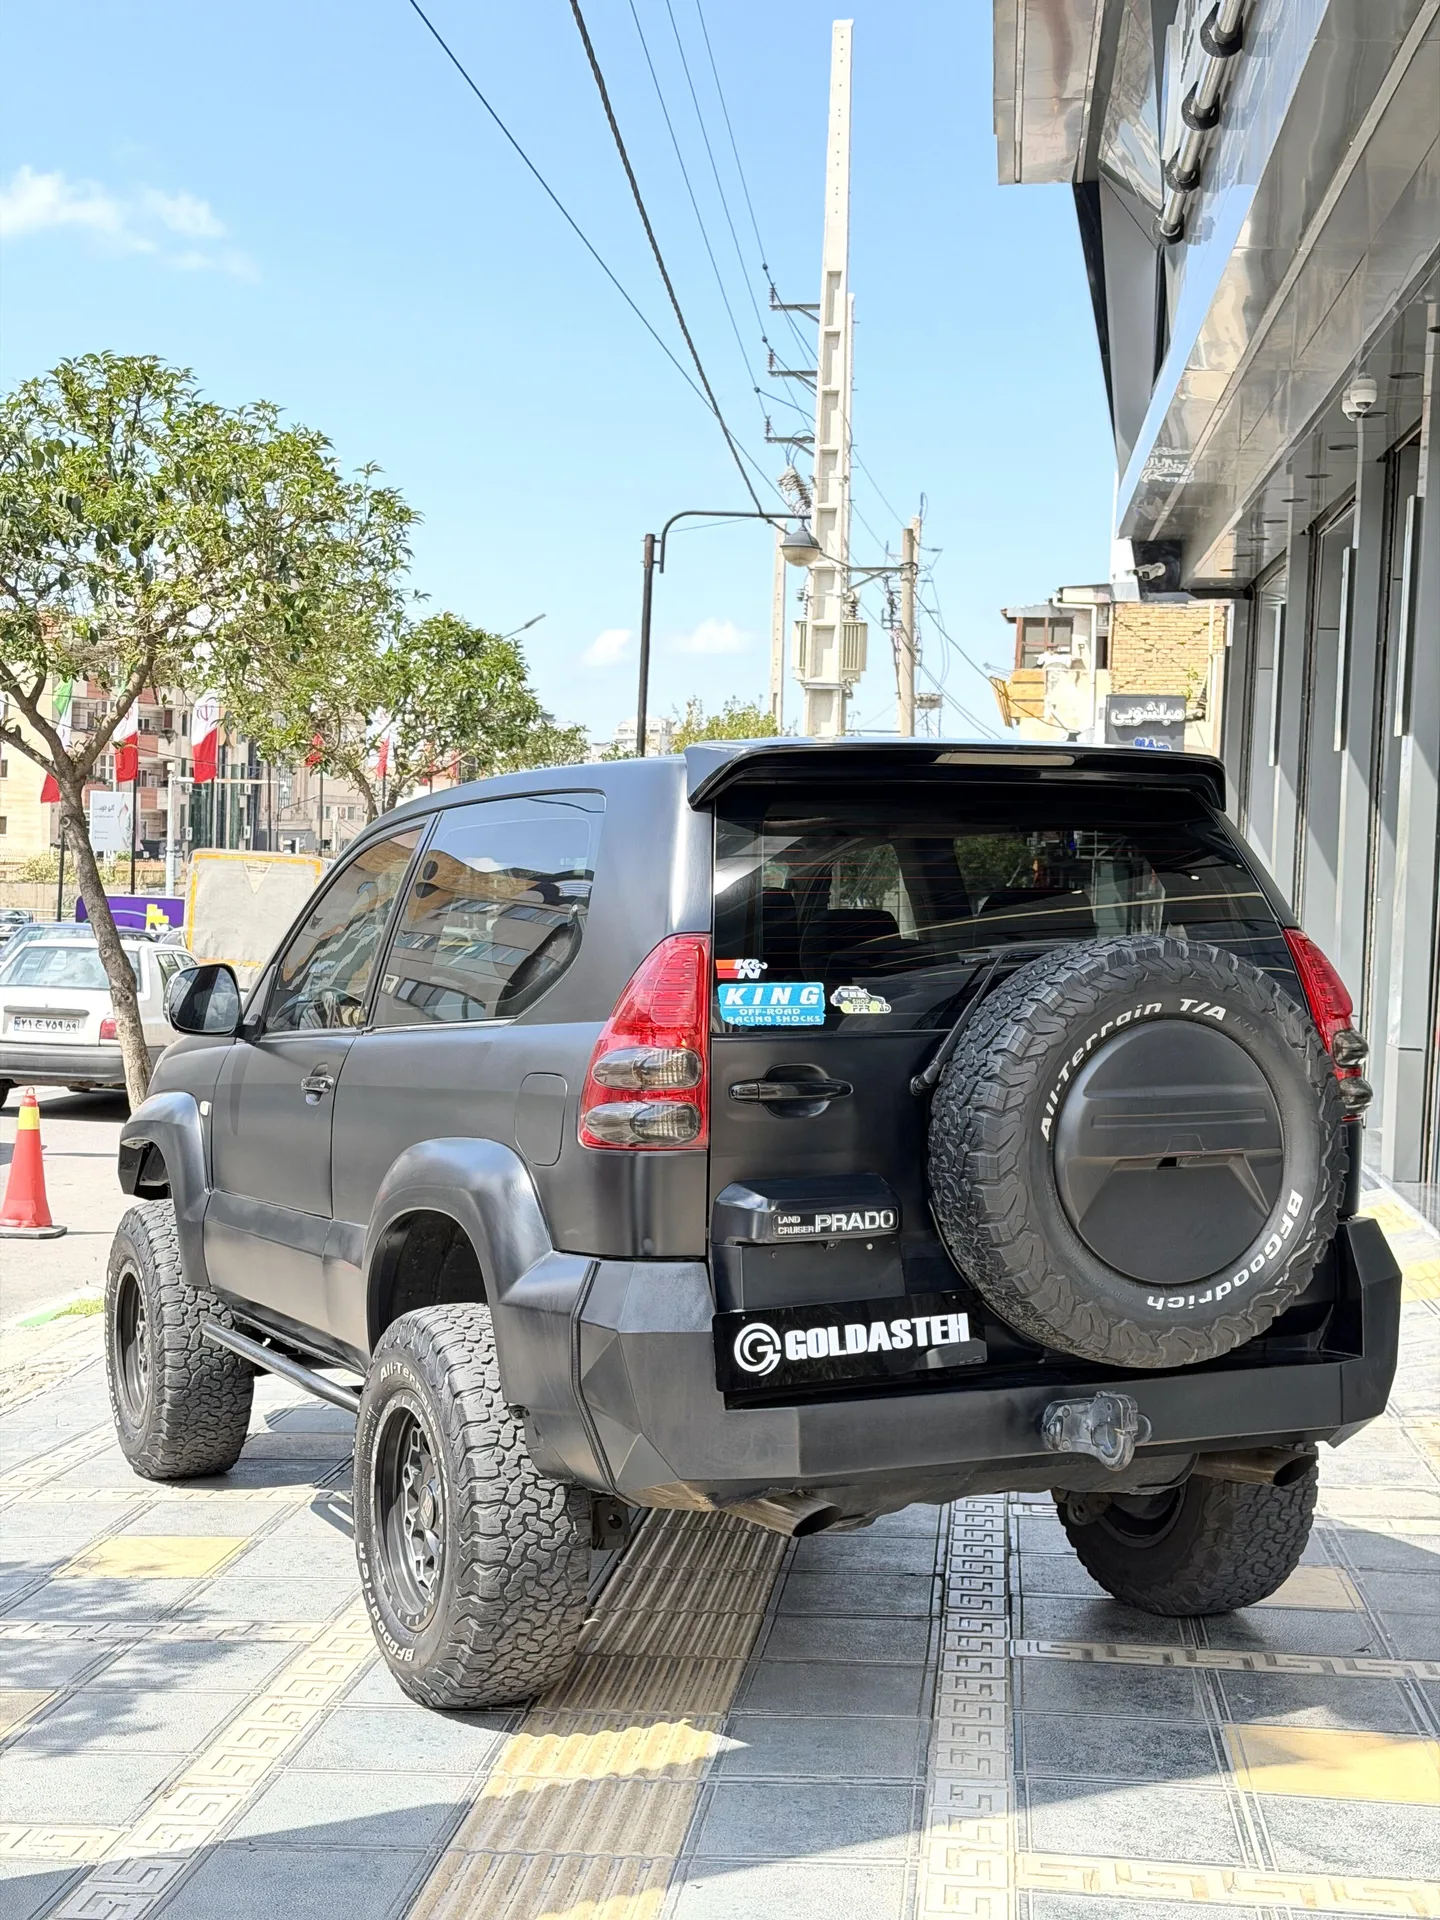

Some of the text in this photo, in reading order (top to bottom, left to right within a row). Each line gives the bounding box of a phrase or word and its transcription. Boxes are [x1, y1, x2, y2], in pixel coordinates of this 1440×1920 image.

[725, 987, 820, 1005] KING
[727, 1015, 821, 1024] RACING SHOCKS
[738, 1008, 801, 1016] OFF-ROAD
[1041, 998, 1227, 1142] All-Terrain T/A
[778, 1215, 801, 1225] LAND
[815, 1209, 895, 1233] PRADO
[778, 1225, 815, 1235] CRUISER
[1147, 1189, 1303, 1311] BFGoodrich
[784, 1312, 971, 1361] GOLDASTEH
